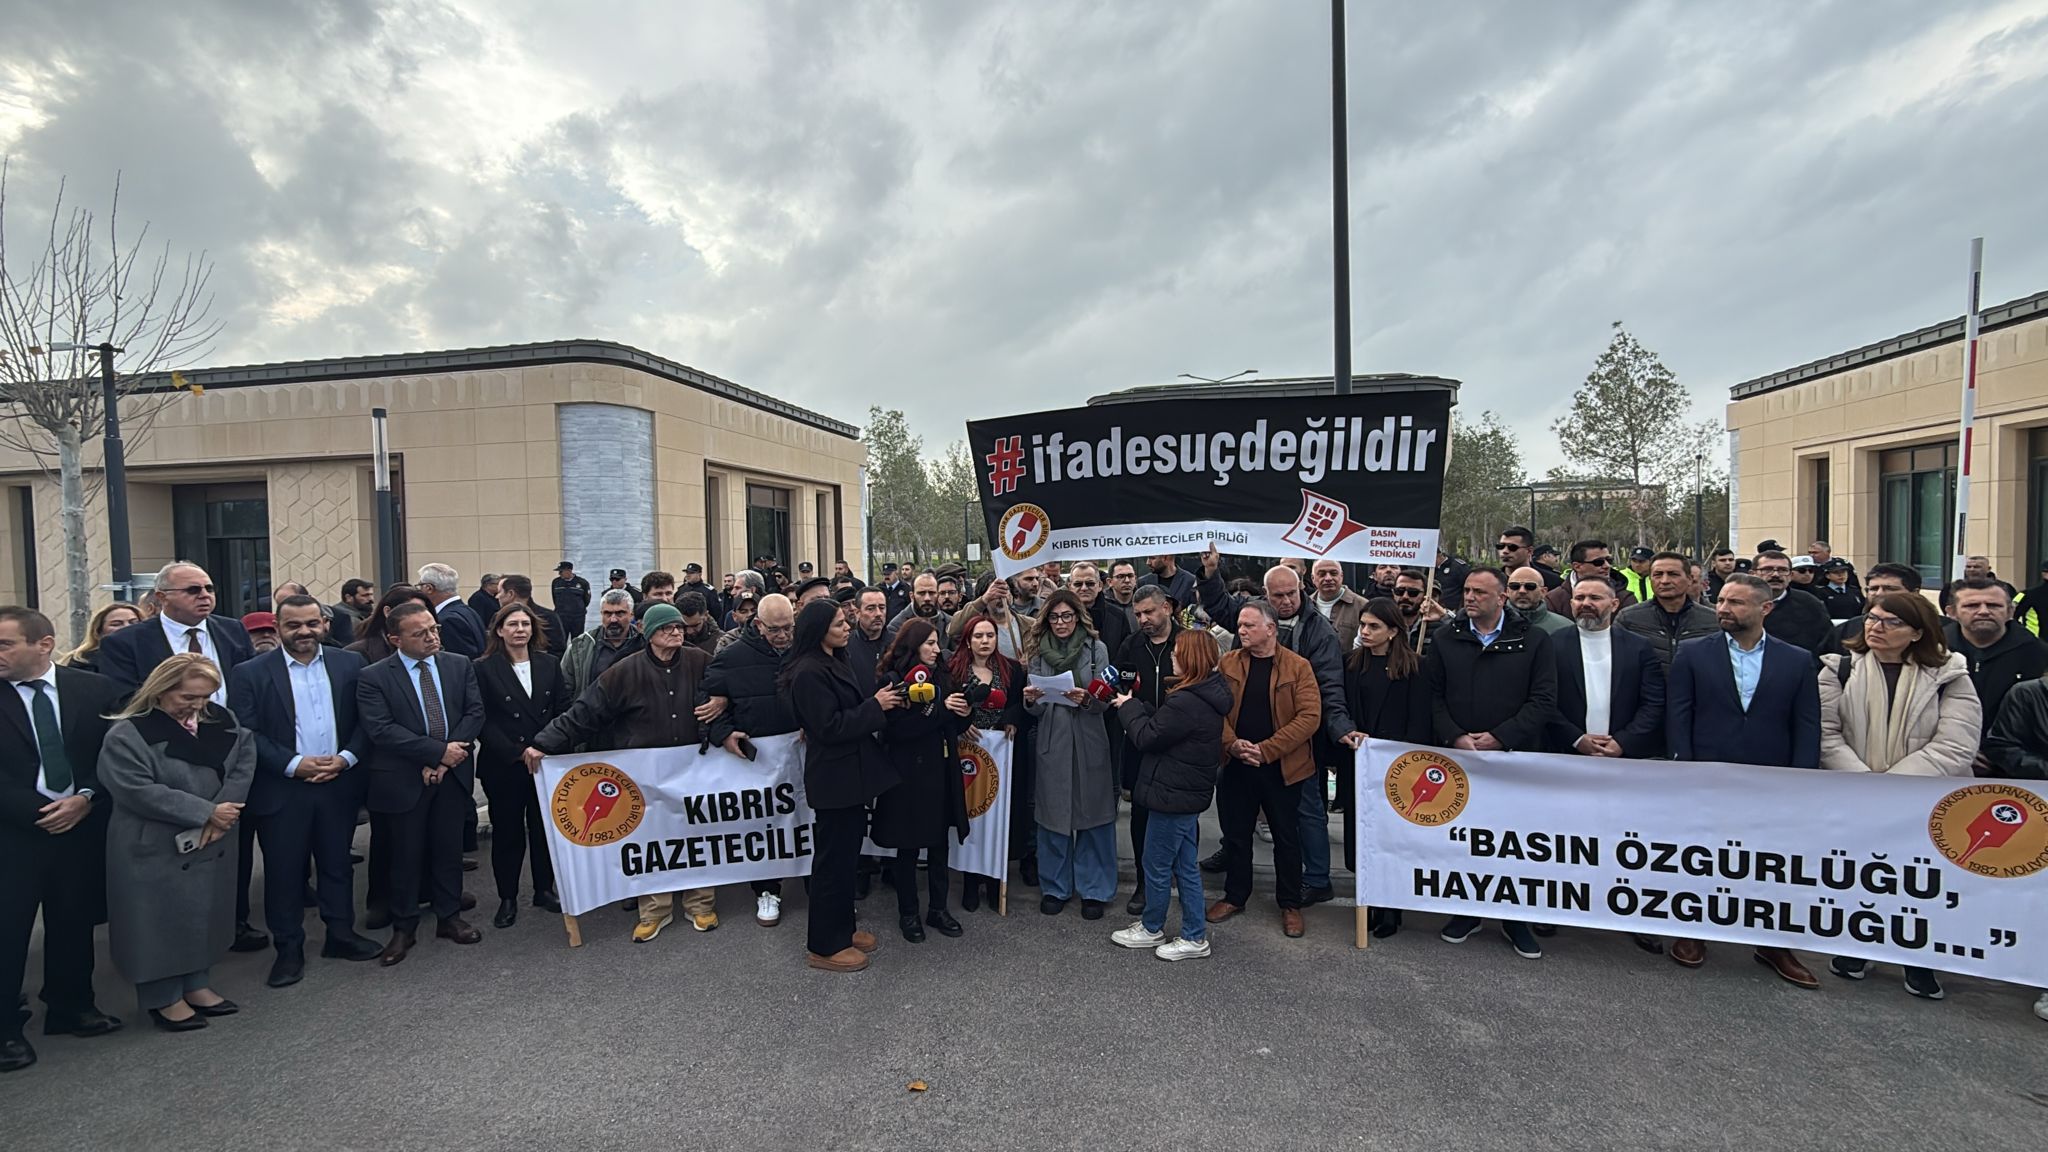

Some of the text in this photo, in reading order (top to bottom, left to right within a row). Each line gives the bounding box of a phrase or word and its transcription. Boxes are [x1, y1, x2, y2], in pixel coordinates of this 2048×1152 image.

[986, 416, 1437, 496] #ifadesuçdeğildir
[1052, 530, 1248, 550] KIBRIS TÜRK GAZETECİLER BİRLİĞİ
[1370, 529, 1397, 538] BASIN
[1370, 539, 1421, 549] EMEKÇİLERİ
[1369, 550, 1416, 559] SENDİKASI
[557, 767, 641, 837] KIBRIS TÜRK GAZETECİLER BİRLİĞİ
[684, 783, 796, 824] KIBRIS
[1389, 753, 1465, 822] KIBRIS TÜRK GAZETECİLER BİRLİĞİ
[1932, 788, 1973, 820] TURKISH
[1415, 812, 1439, 823] 1982
[589, 830, 615, 842] 1982
[621, 823, 816, 876] GAZETECİLE
[1931, 822, 1959, 860] CYPRUS
[1615, 831, 1961, 908] ÖZGÜRLÜĞÜ,
[1968, 861, 1998, 876] 1982
[1413, 868, 1591, 911] HAYATIN
